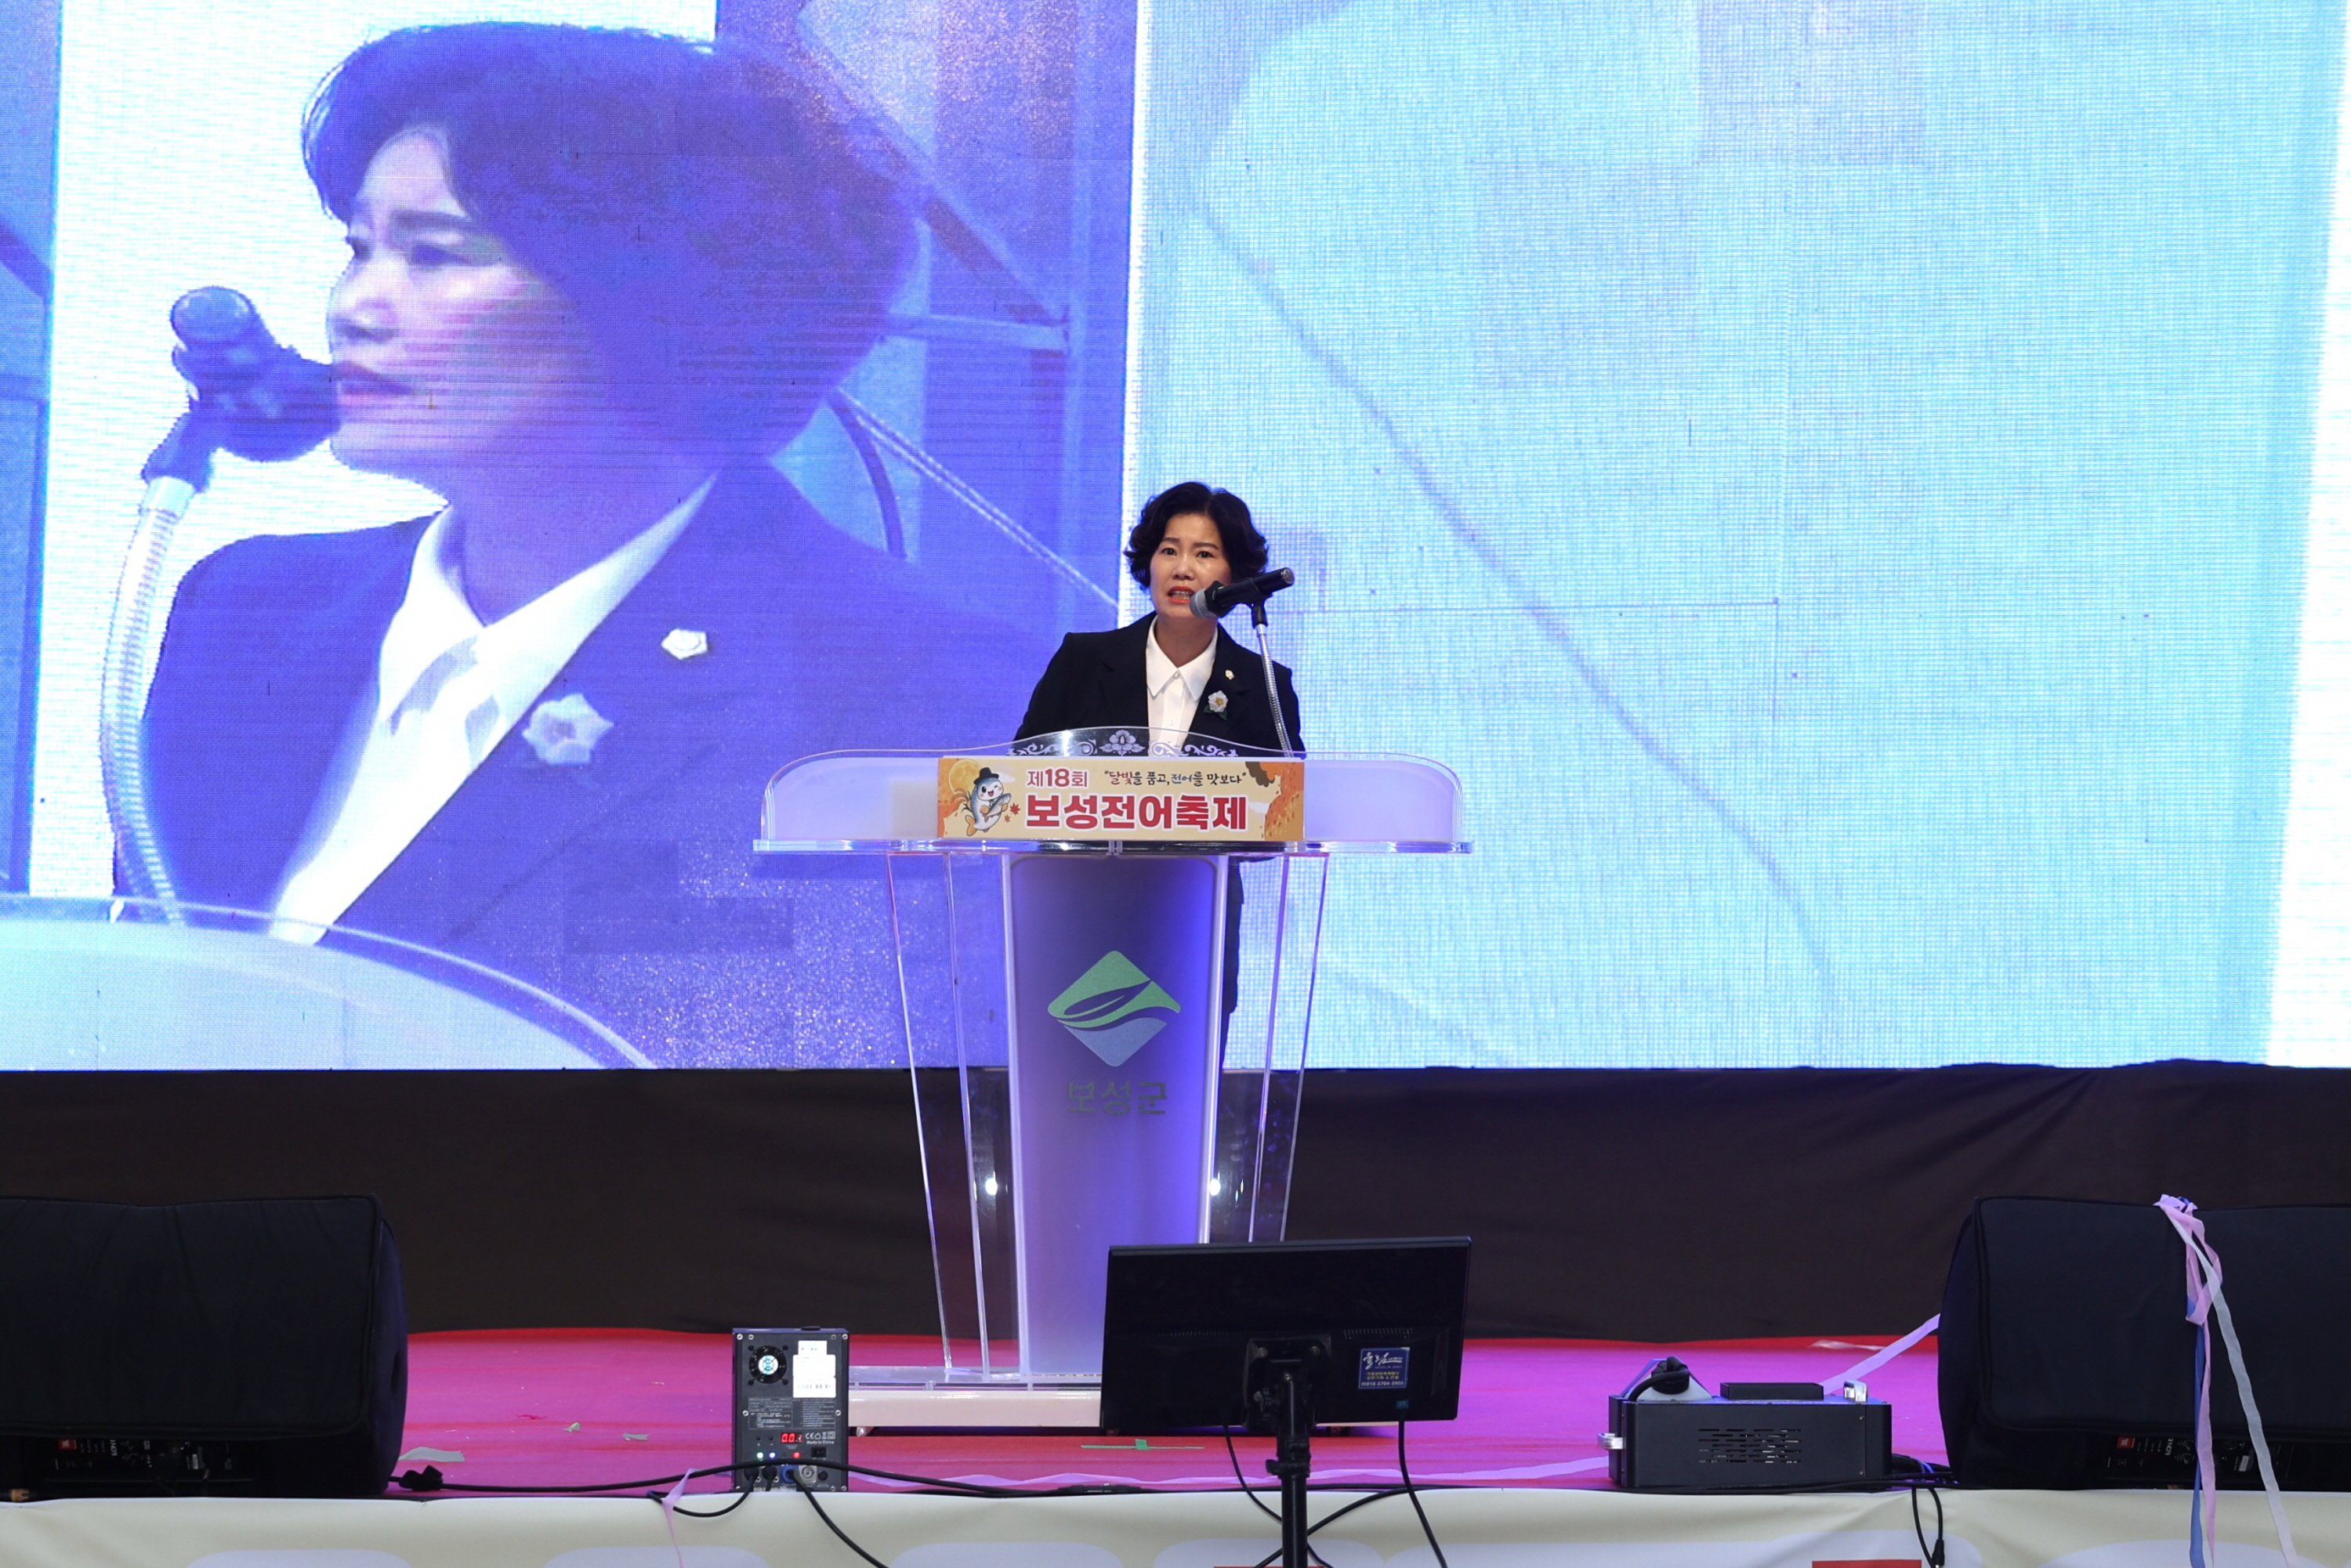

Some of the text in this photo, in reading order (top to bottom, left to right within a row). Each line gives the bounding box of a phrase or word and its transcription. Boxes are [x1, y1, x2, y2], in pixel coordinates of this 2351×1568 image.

[1027, 768, 1088, 787] 제18회
[1146, 771, 1170, 786] 품고,
[1171, 771, 1203, 787] 전어를
[1027, 795, 1246, 830] 보성전어축제
[1067, 1081, 1166, 1116] 보성군
